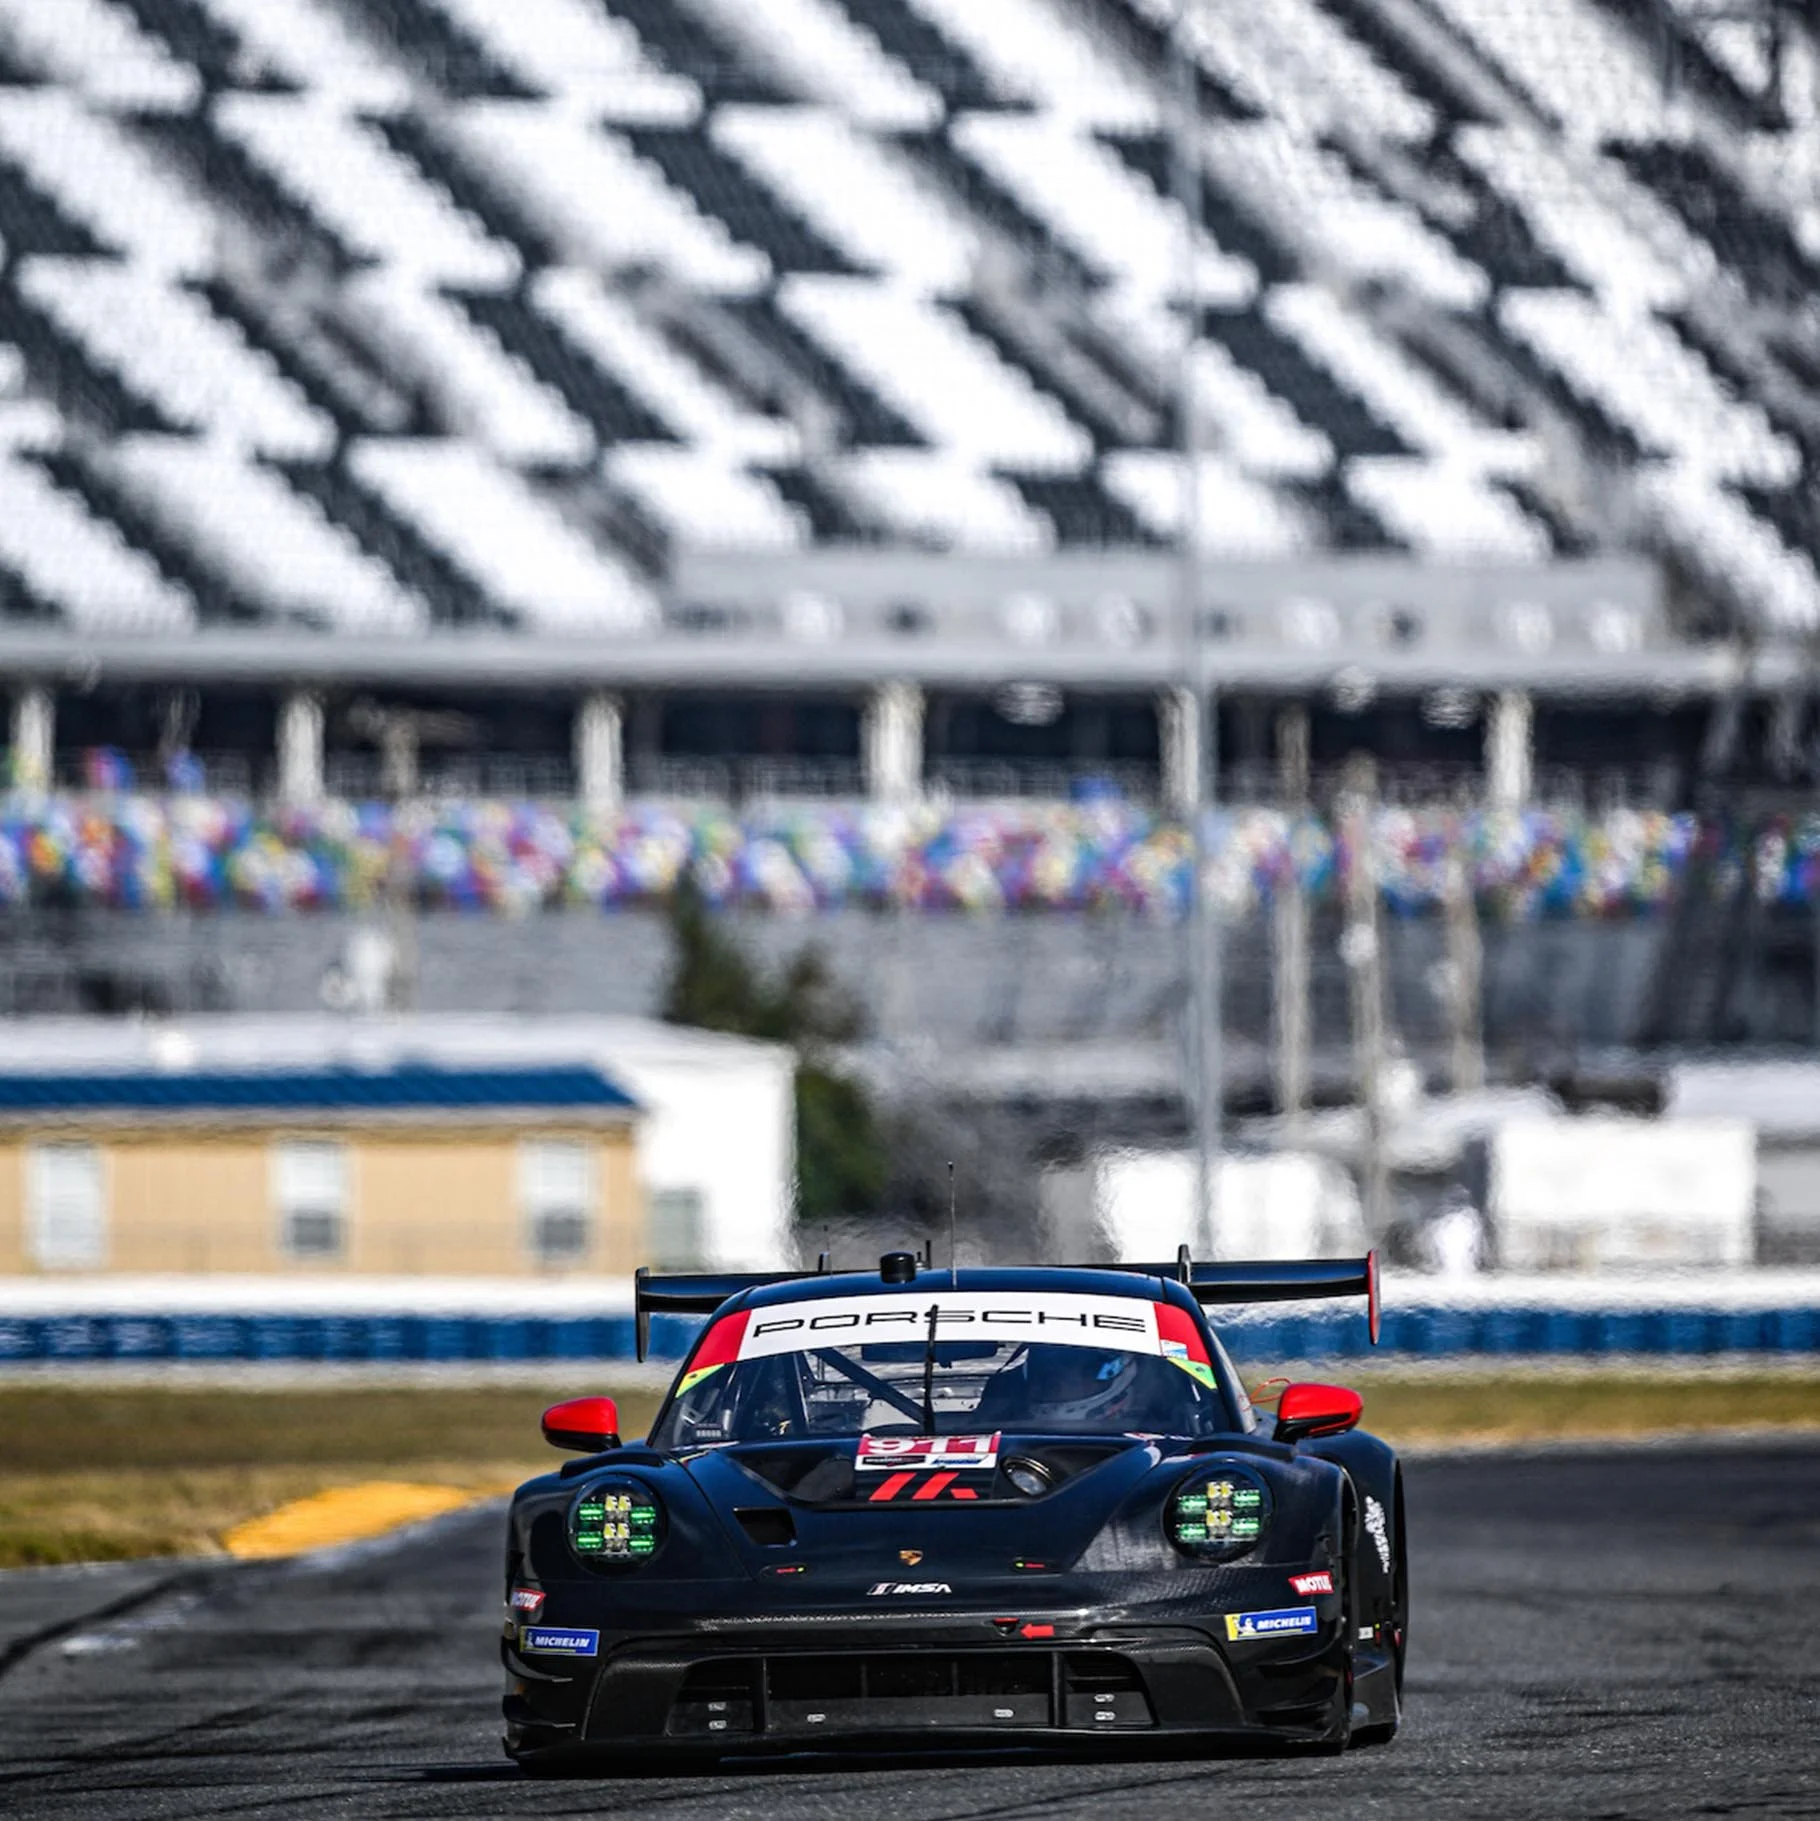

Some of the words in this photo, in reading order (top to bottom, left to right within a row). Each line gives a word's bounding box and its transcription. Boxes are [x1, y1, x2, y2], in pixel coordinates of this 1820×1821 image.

[753, 1310, 1147, 1338] PORSCHE
[867, 1438, 993, 1454] 911
[892, 1583, 952, 1595] IMSA
[1257, 1616, 1312, 1631] MICHELIN
[534, 1636, 590, 1648] MICHELIN
